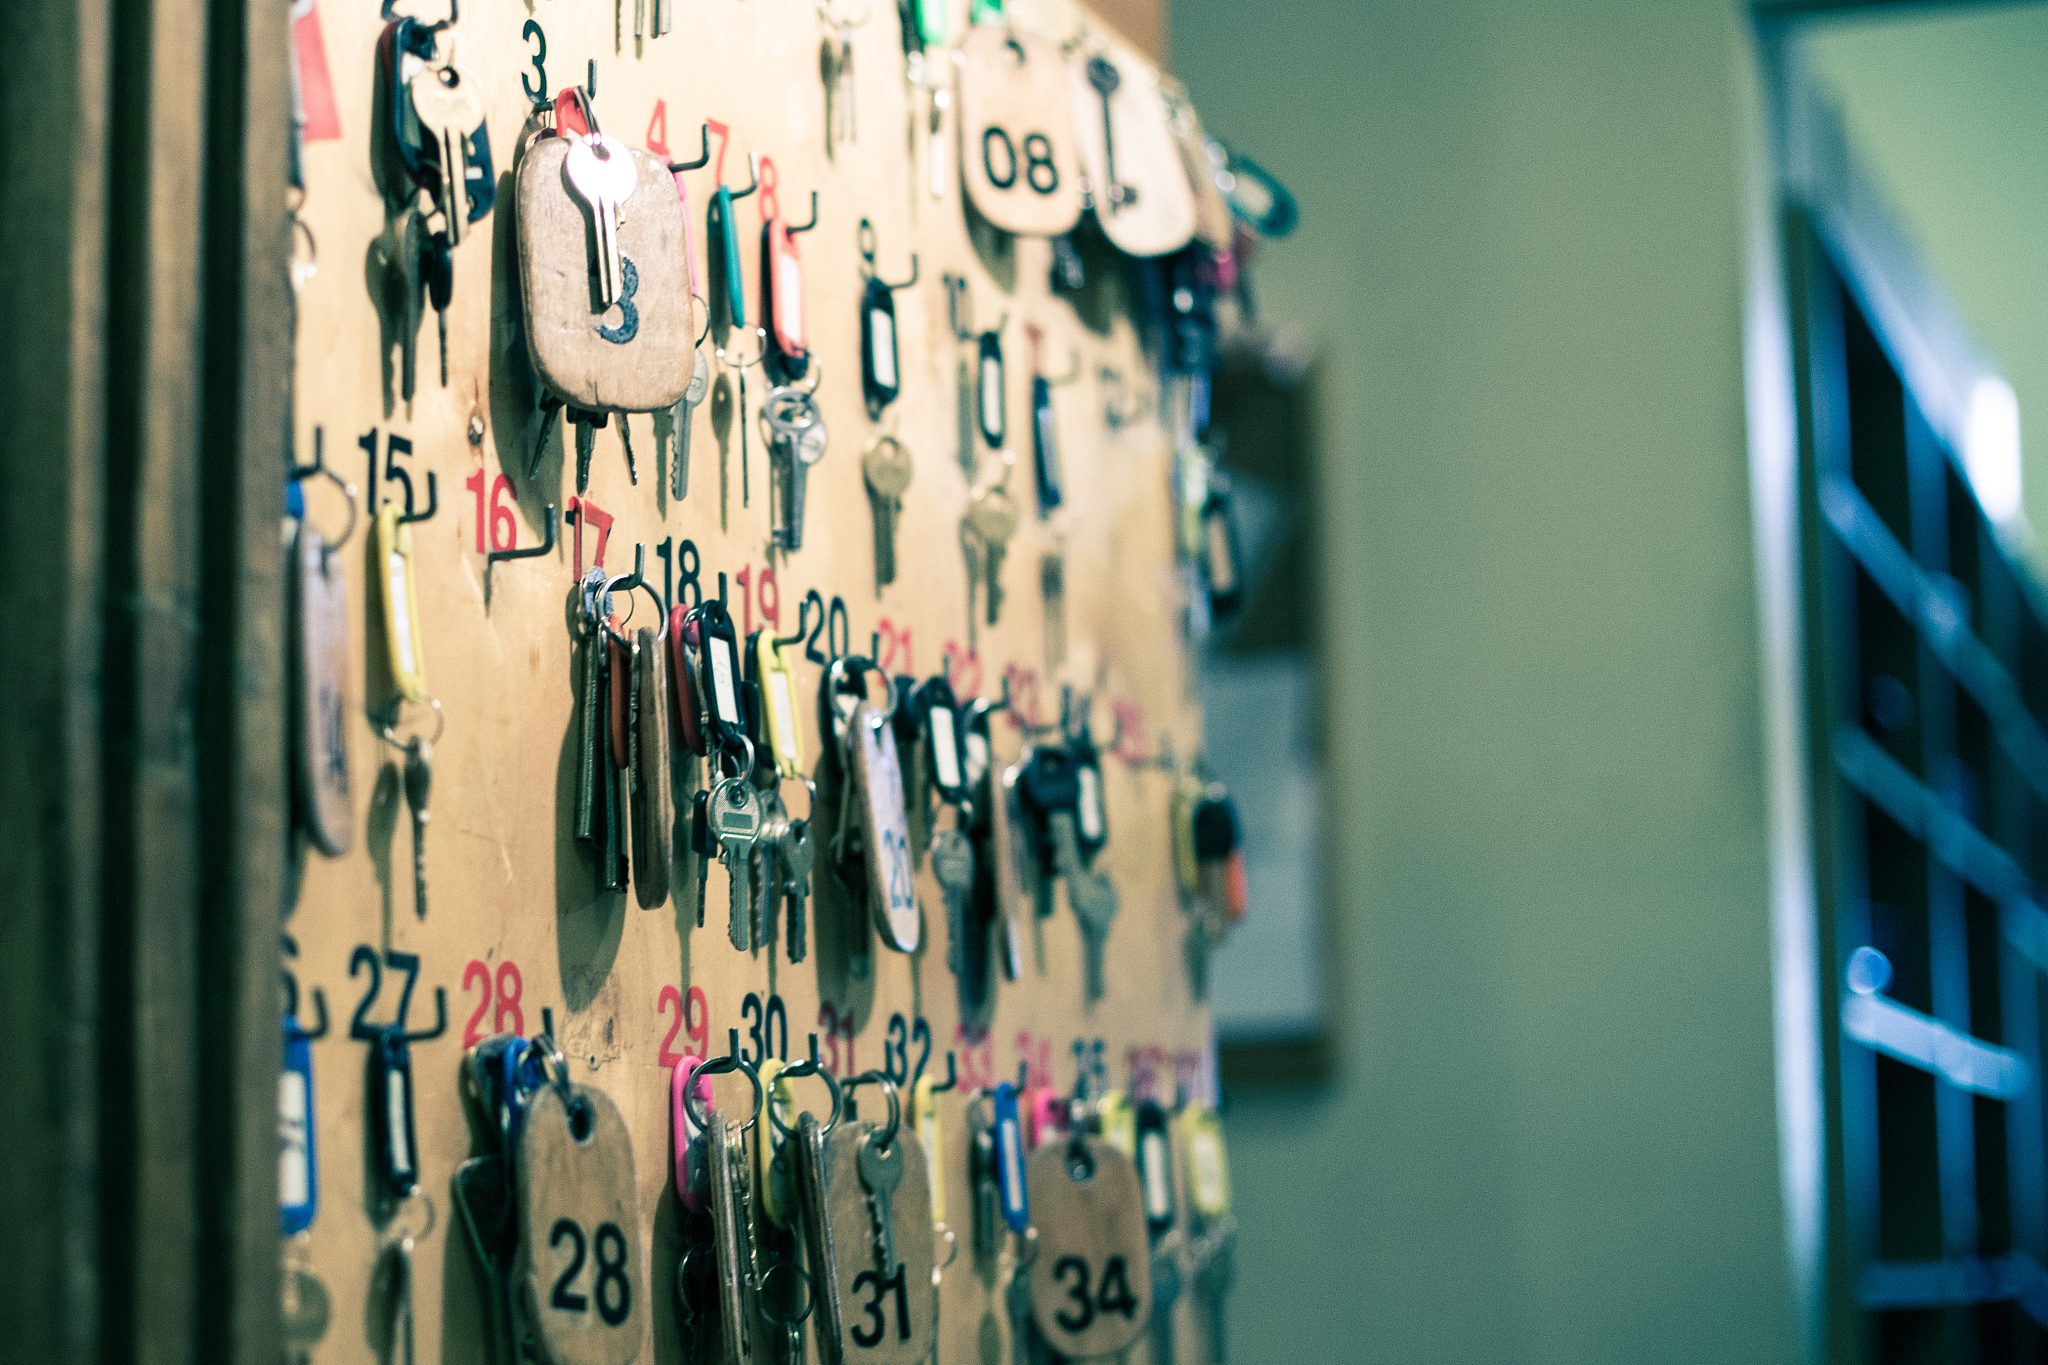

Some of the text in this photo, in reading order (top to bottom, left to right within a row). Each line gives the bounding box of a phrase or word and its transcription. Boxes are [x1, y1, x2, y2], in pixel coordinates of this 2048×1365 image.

[521, 19, 547, 103] 3
[705, 116, 729, 188] 7
[980, 125, 1059, 195] 08
[592, 255, 639, 345] 3
[357, 426, 414, 516] 15
[466, 468, 519, 554] 16
[565, 495, 615, 583] 17
[656, 535, 701, 612] 18
[736, 562, 780, 637] 19
[804, 588, 850, 665] 20
[349, 943, 420, 1041] 27
[462, 959, 525, 1050] 28
[656, 984, 710, 1069] 29
[741, 992, 789, 1065] 30
[818, 1002, 856, 1078] 31
[888, 1012, 932, 1090] 32
[548, 1217, 633, 1327] 28
[849, 1261, 912, 1349] 31
[1052, 1254, 1138, 1333] 34
